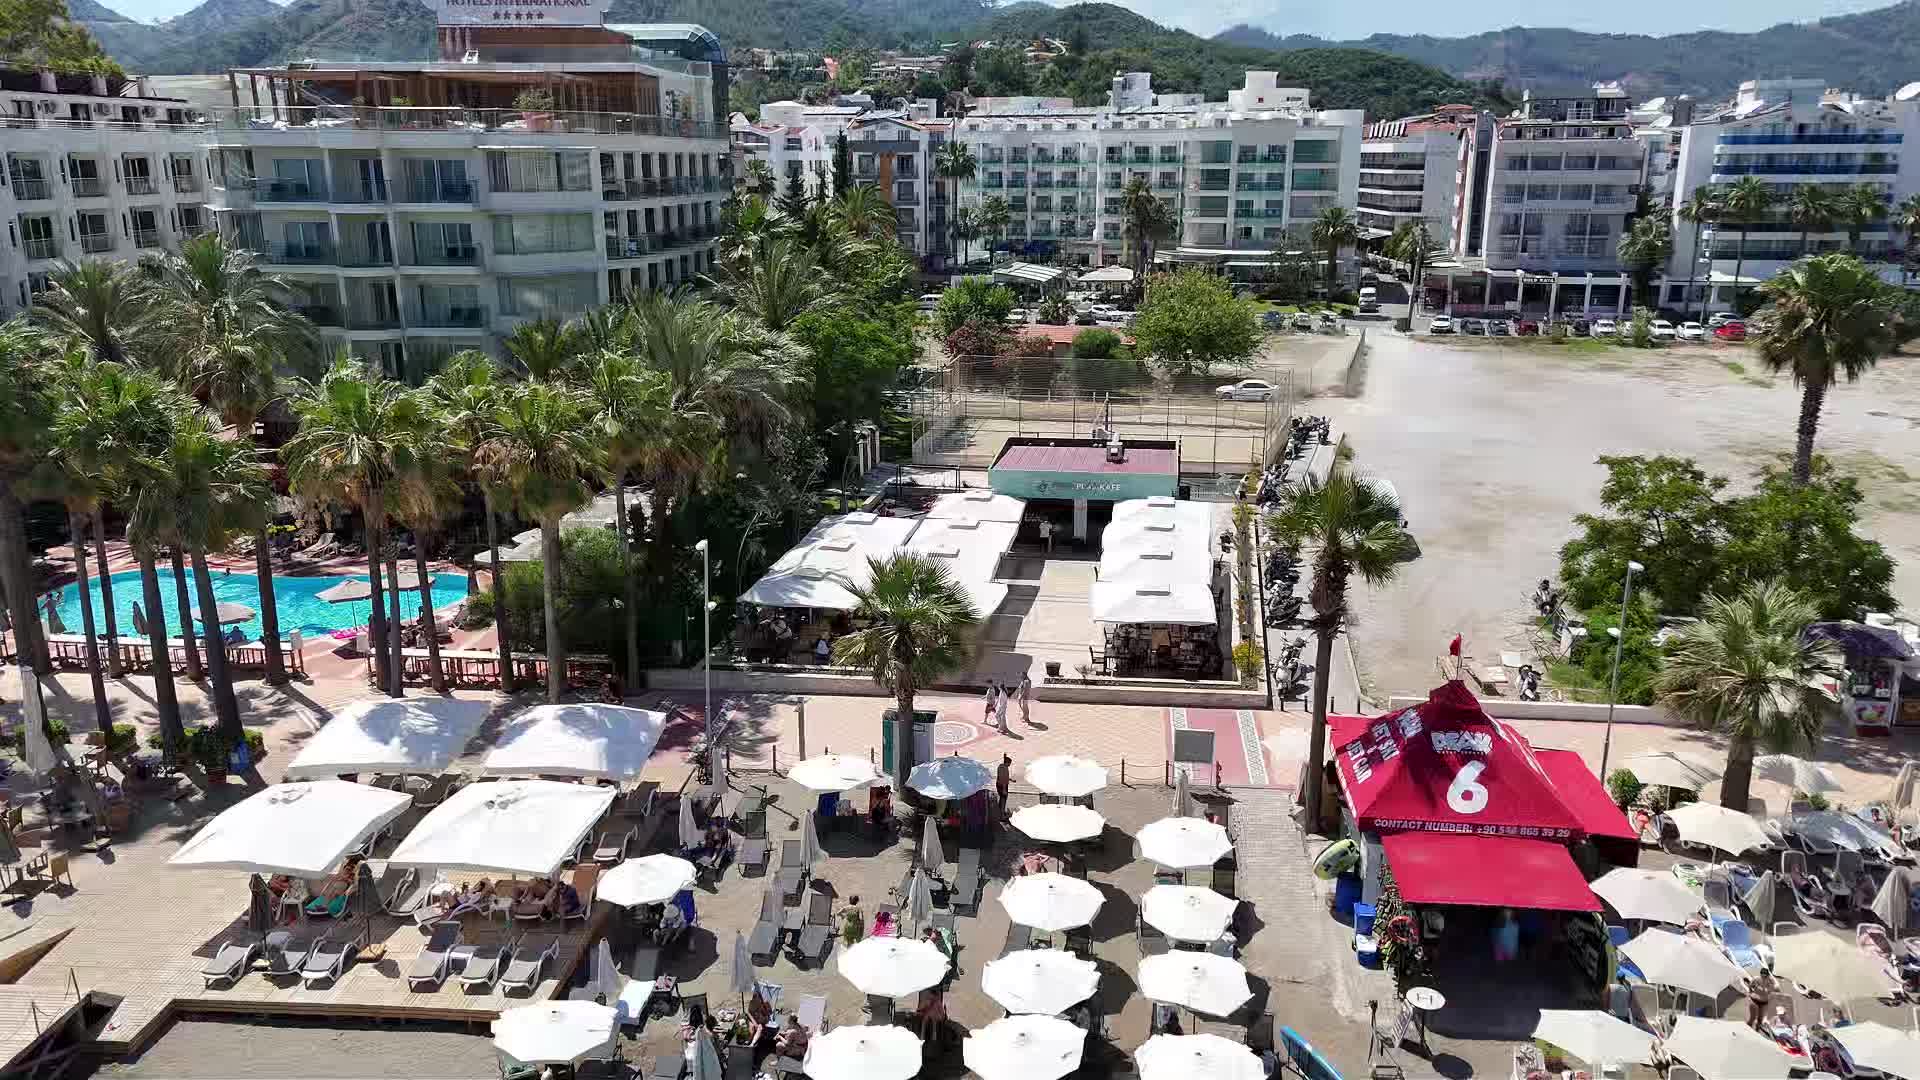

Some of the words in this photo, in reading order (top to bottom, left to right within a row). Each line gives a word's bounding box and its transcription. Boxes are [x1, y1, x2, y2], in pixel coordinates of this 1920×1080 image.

[1447, 760, 1489, 814] 6
[1375, 819, 1423, 830] CONTACT
[1424, 821, 1473, 833] NUMBER:
[1476, 824, 1496, 834] +90
